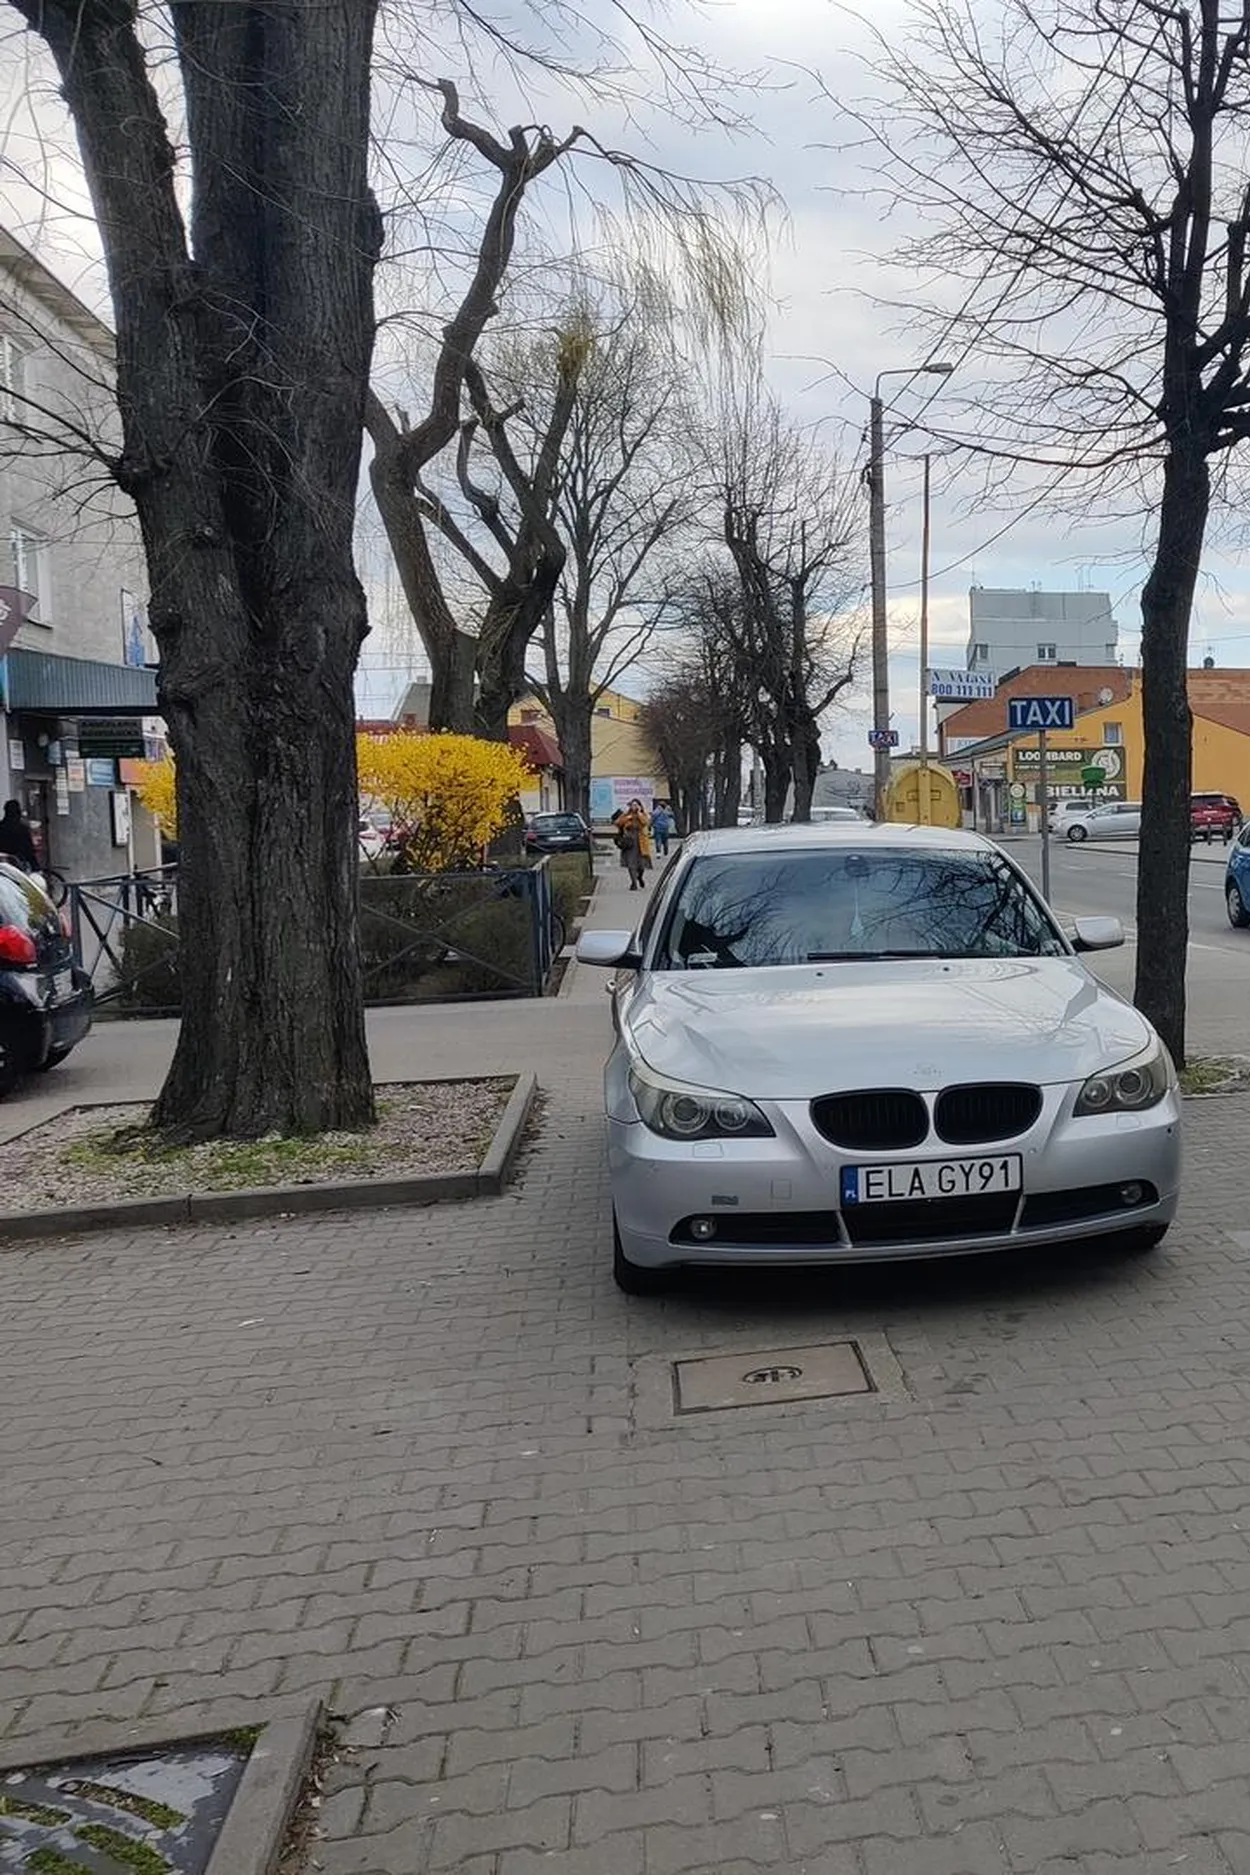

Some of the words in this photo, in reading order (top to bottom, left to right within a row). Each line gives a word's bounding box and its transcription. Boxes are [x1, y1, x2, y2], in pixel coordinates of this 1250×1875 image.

[931, 683, 953, 695] 800
[957, 685, 973, 696] 111
[976, 685, 992, 697] 111
[1011, 700, 1071, 726] TAXI
[871, 732, 897, 743] TAXI
[865, 1167, 926, 1199] ELA
[938, 1159, 1010, 1193] GY91
[845, 1190, 857, 1199] PL
